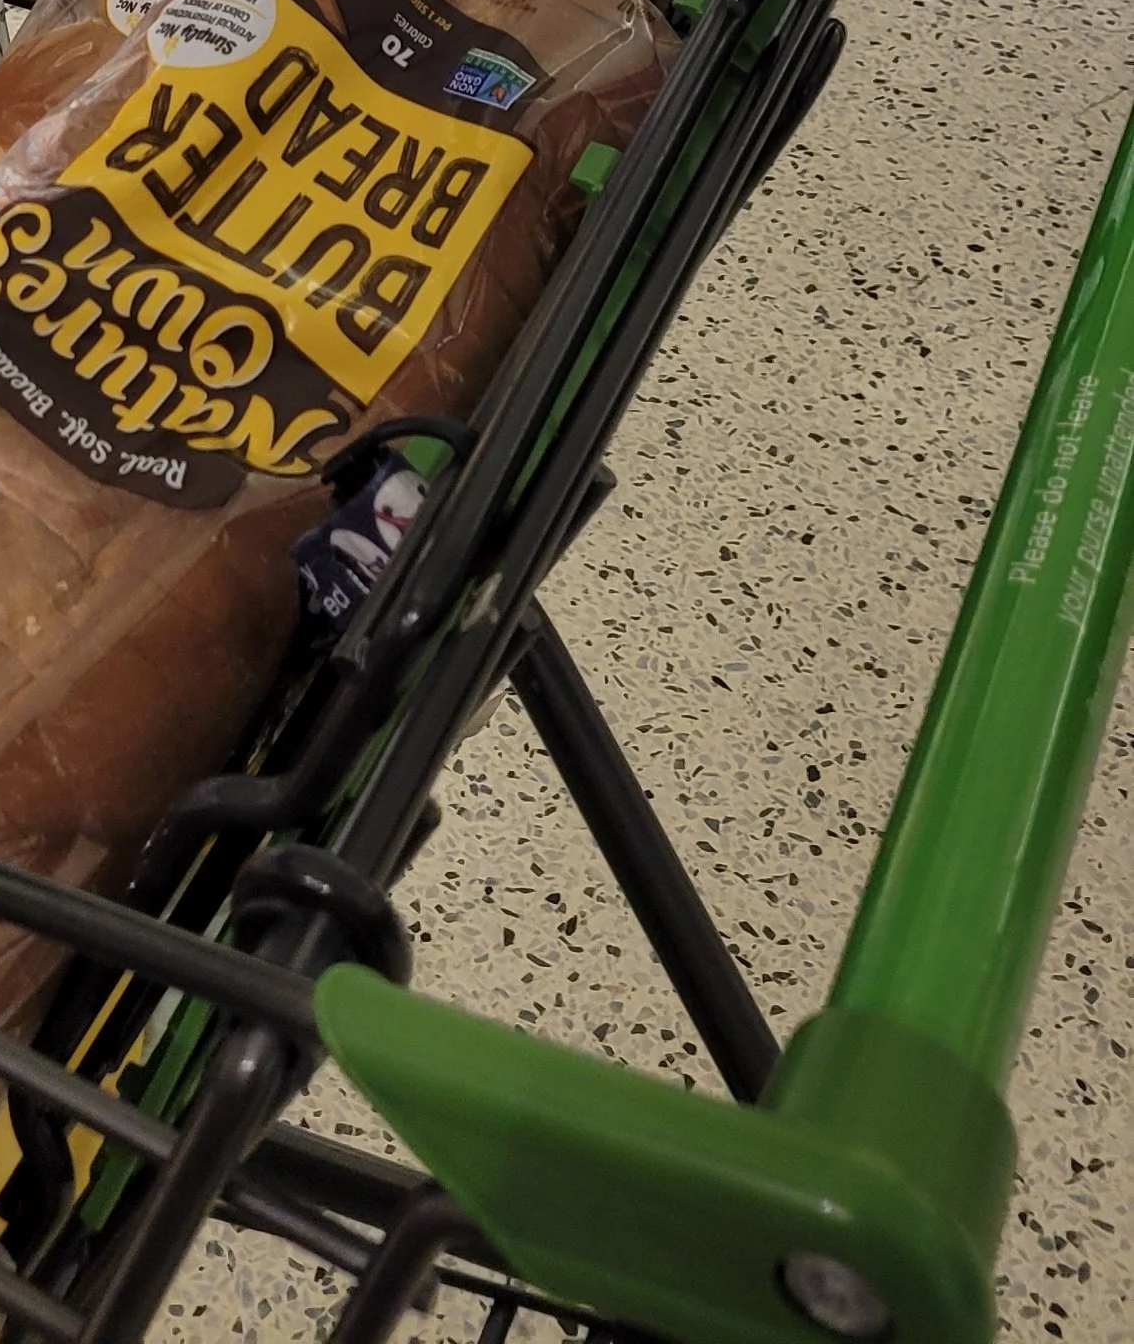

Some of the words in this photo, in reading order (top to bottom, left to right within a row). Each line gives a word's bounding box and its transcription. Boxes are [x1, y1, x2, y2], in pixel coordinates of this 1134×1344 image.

[215, 16, 257, 44] Artificial
[221, 5, 252, 24] Colors
[393, 11, 434, 51] Calories
[434, 14, 455, 33] per
[155, 21, 182, 39] No:
[180, 23, 238, 56] Simply
[380, 32, 416, 69] 70
[448, 79, 479, 96] NON
[453, 70, 483, 88] GMO
[243, 45, 490, 250] BREAD
[105, 81, 434, 359] BUTTER
[60, 216, 276, 391] Own
[59, 403, 114, 466] Soft.
[121, 449, 188, 490] Real.
[1008, 509, 1058, 585] Please
[1034, 472, 1065, 506] do
[1051, 421, 1079, 477] not
[1065, 373, 1100, 430] leave
[1059, 568, 1090, 627] your
[1075, 495, 1113, 572] purse
